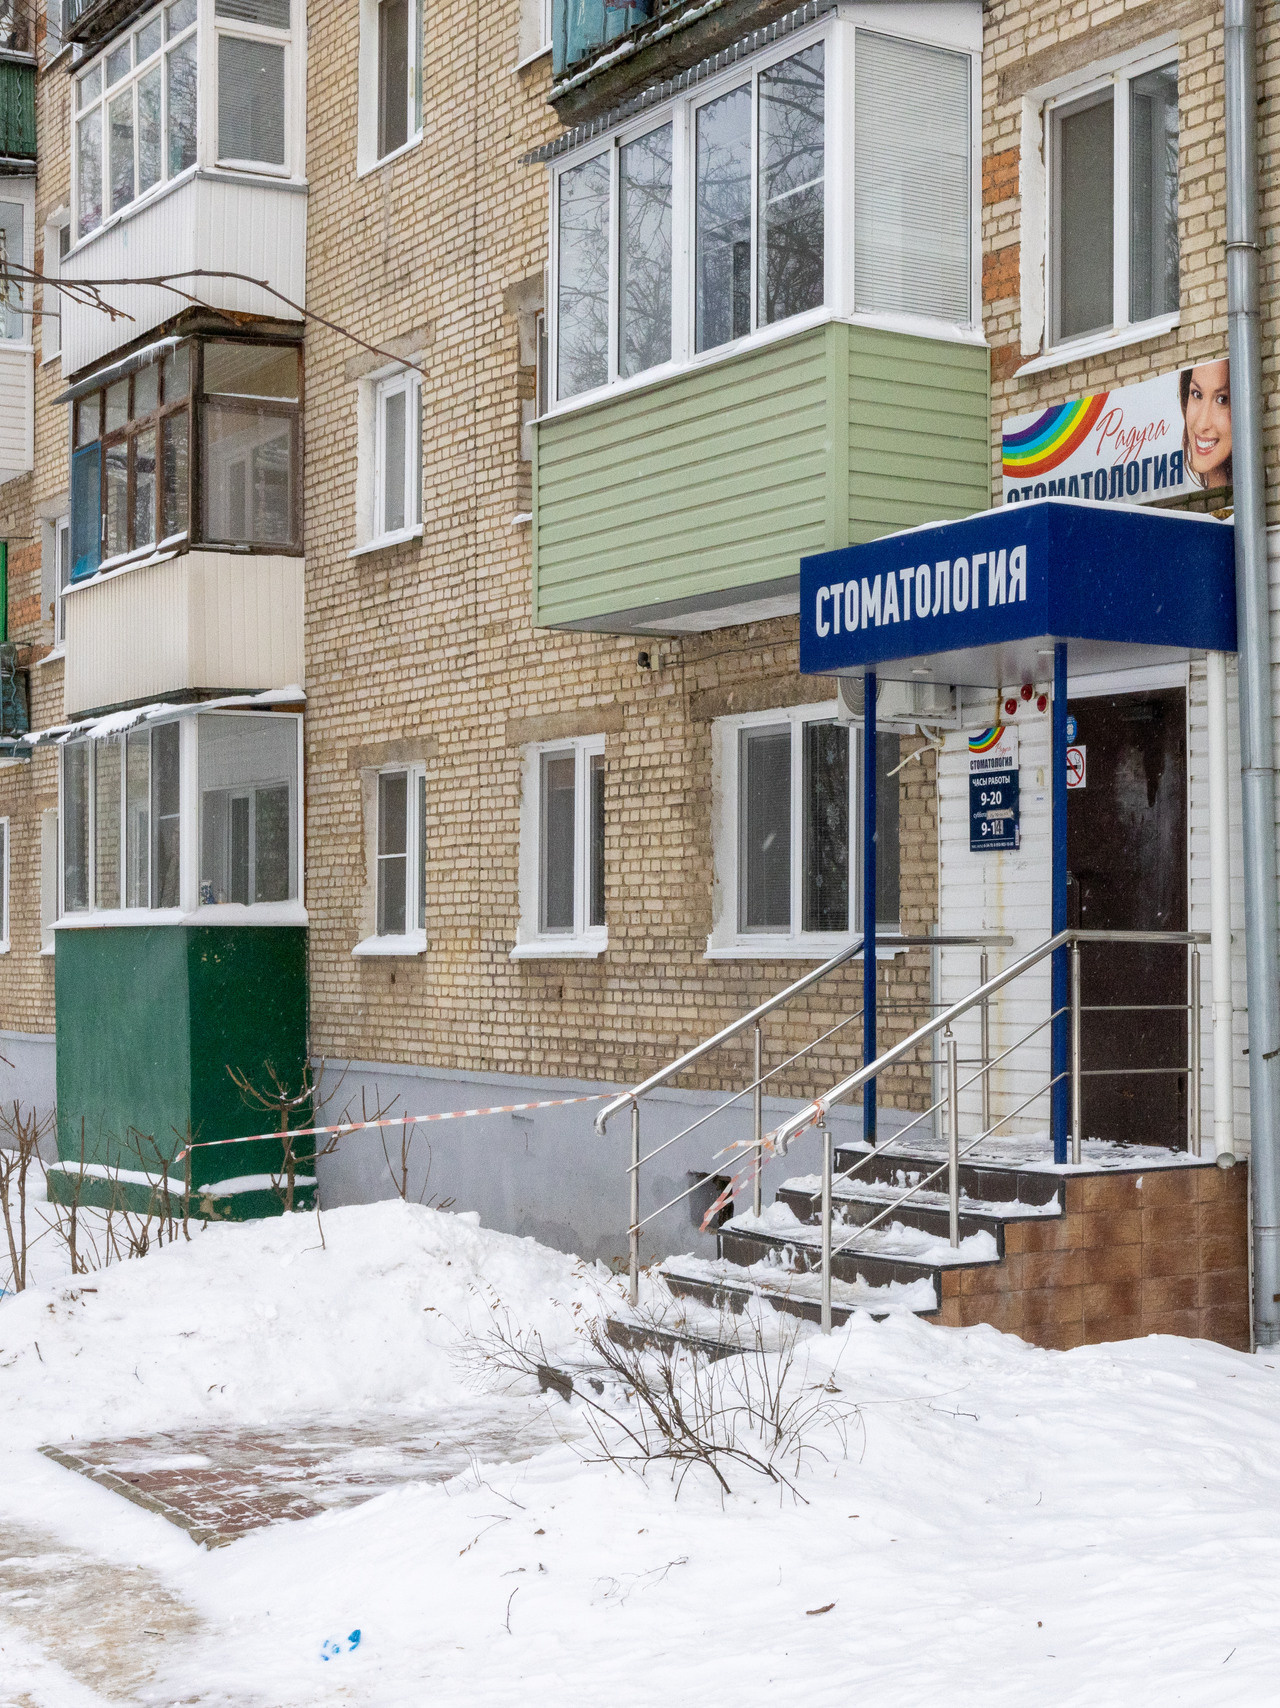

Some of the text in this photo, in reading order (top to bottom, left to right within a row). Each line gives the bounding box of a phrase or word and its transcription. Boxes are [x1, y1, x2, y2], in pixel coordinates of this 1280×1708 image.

[1095, 407, 1170, 472] Радуга
[815, 544, 1028, 638] СТОМАТОЛОГИЯ
[970, 756, 1013, 771] СТОМАТОЛОГИЯ
[972, 776, 1011, 787] ЧАСЫ РАБОТЫ
[980, 791, 1002, 806] 9-20
